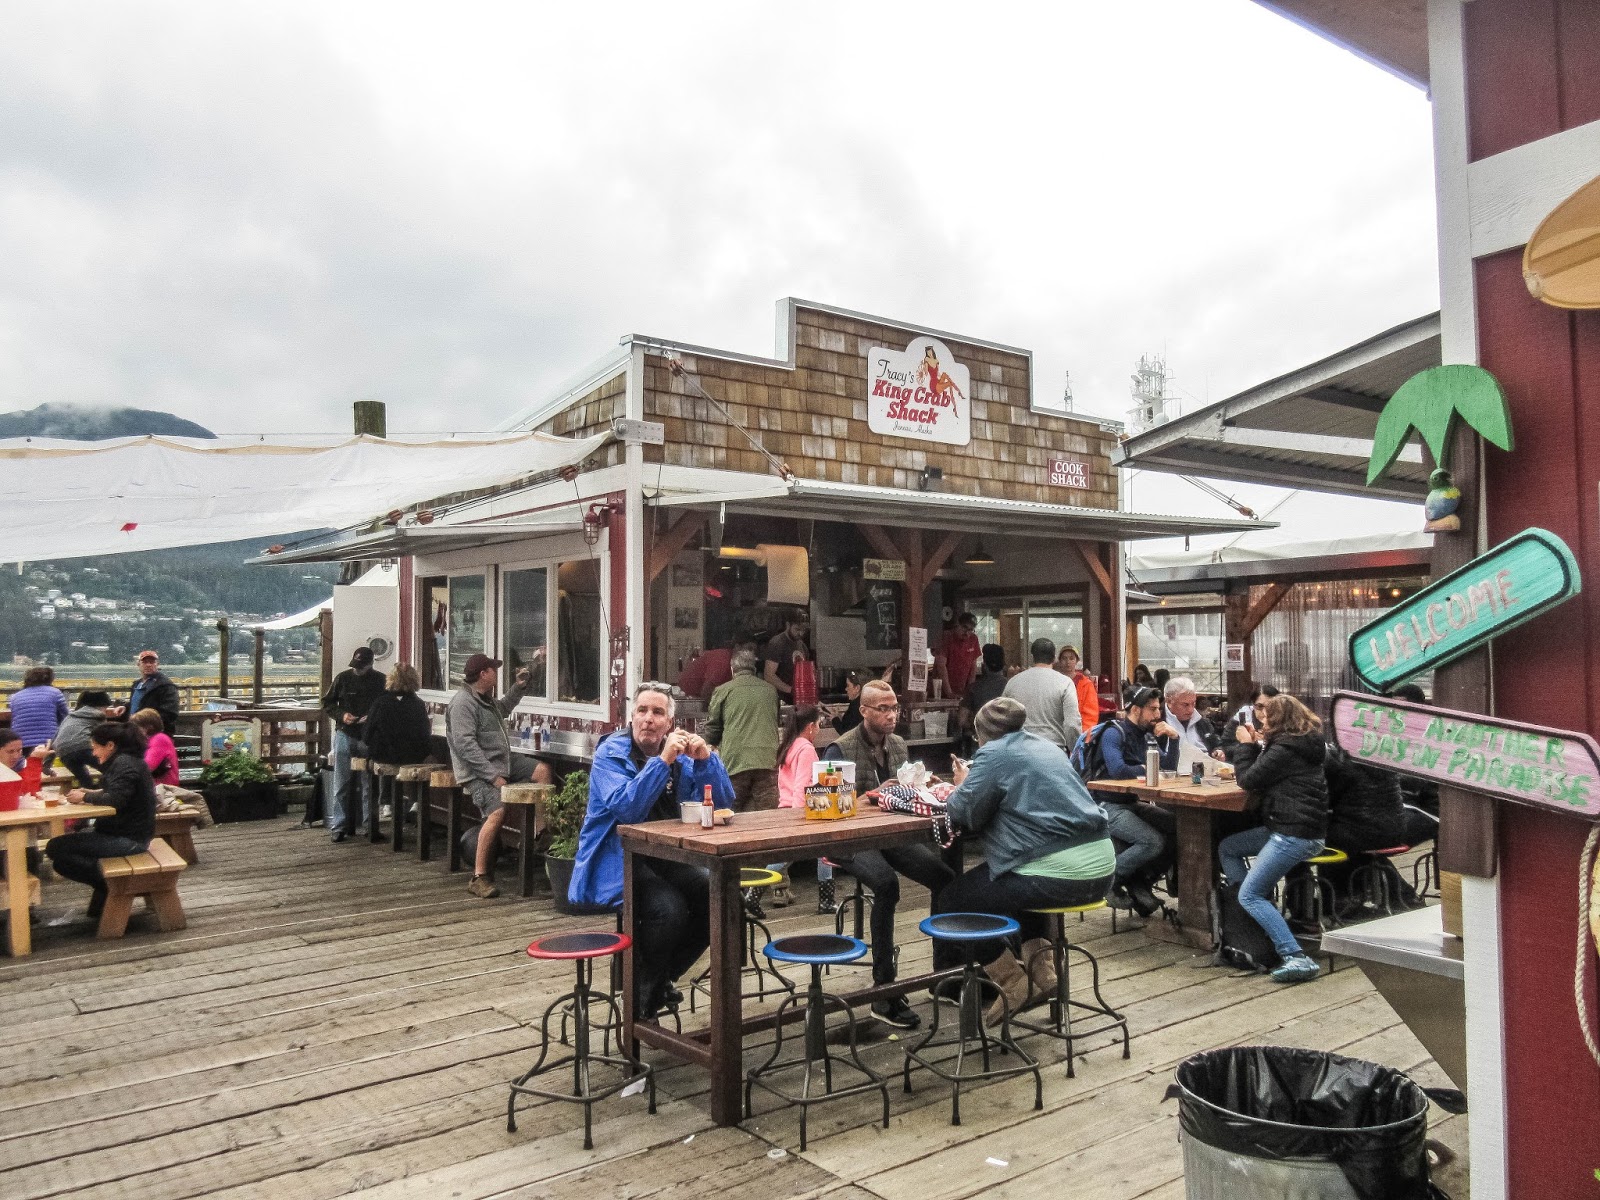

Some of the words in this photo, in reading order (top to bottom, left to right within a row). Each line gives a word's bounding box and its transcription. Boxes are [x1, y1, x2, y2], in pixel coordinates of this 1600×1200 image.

[876, 358, 915, 387] Tracy's
[872, 379, 914, 405] King
[914, 386, 951, 408] Crab
[886, 400, 940, 425] Shack
[1051, 472, 1087, 487] SHACK
[1055, 461, 1084, 475] COOK
[1369, 569, 1520, 671] WELCOME
[1352, 702, 1406, 734] IT'S
[1422, 716, 1566, 768] ANOTHER
[1358, 730, 1411, 762] DAY
[1446, 748, 1593, 807] PARADISE
[806, 786, 832, 794] ALASKAN
